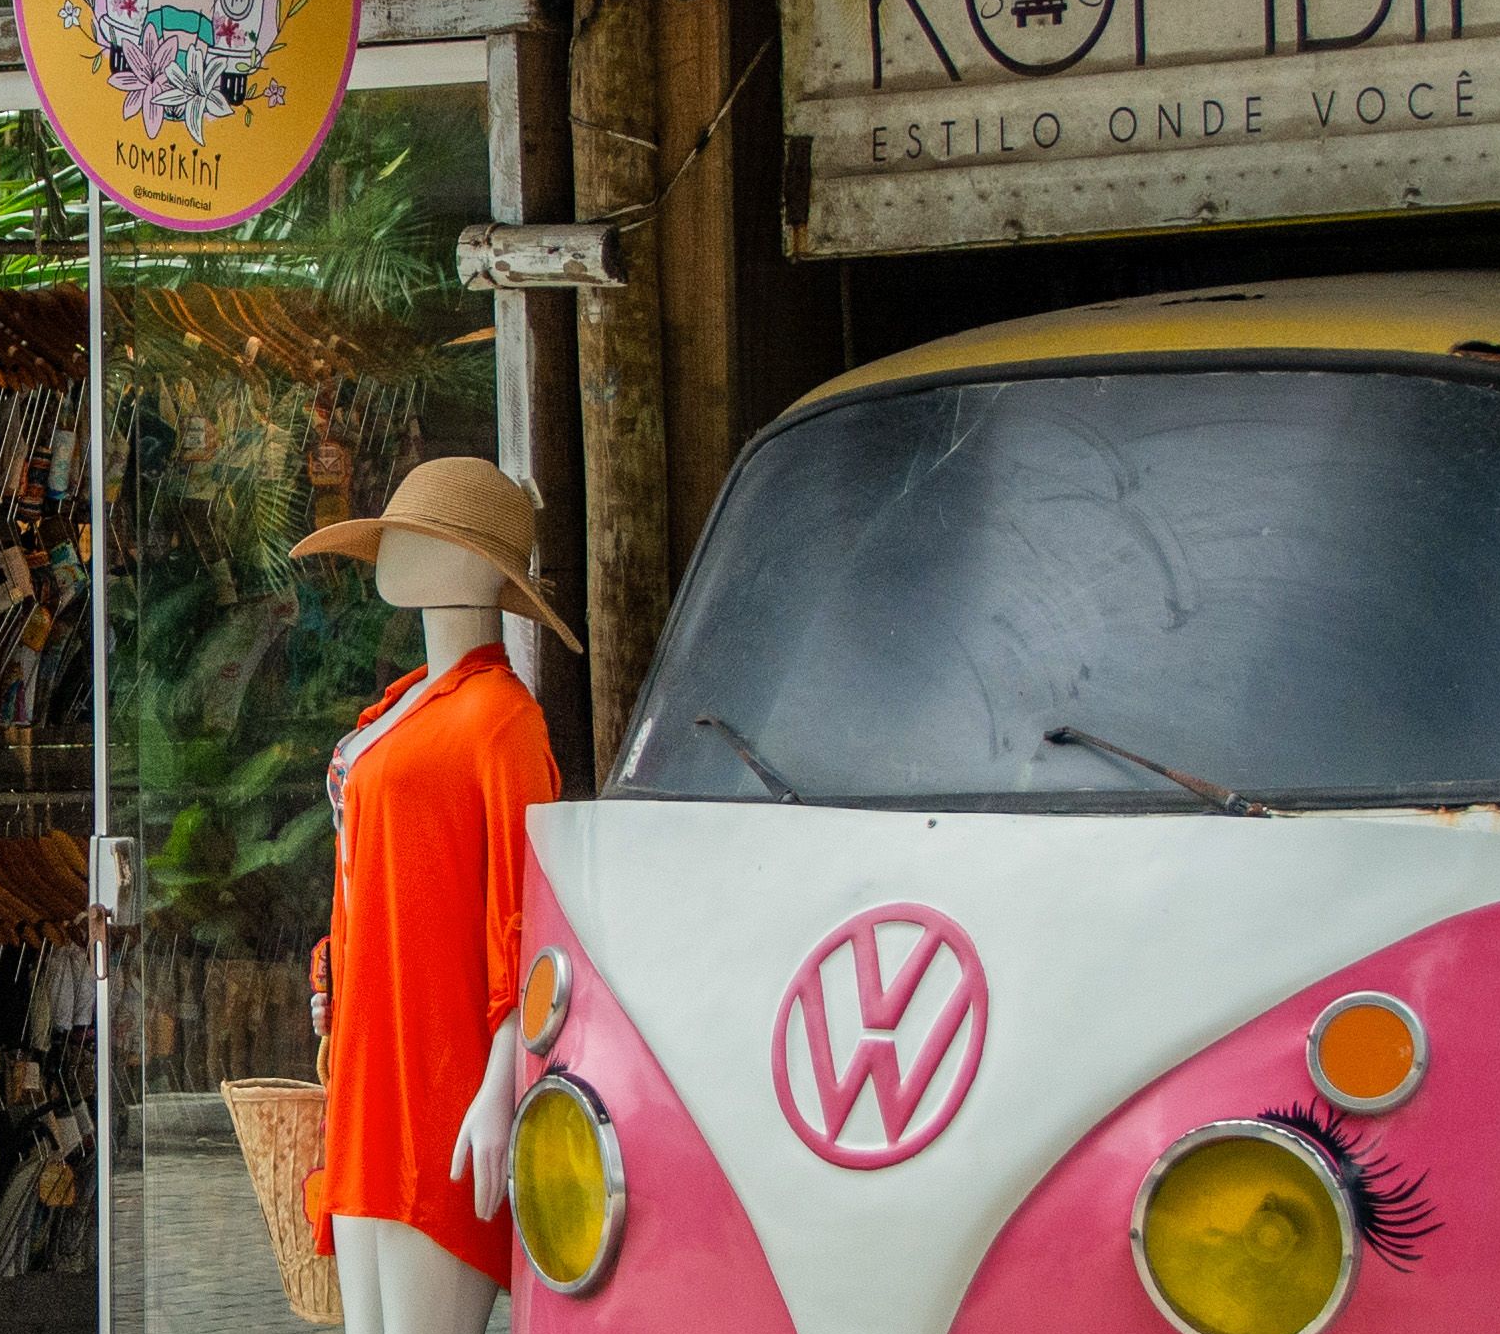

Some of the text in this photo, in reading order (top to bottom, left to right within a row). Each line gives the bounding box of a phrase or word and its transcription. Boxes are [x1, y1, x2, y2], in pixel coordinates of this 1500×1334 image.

[871, 111, 1063, 164] ESTILO
[1108, 94, 1264, 144] ONDE
[1310, 69, 1478, 129] VOCÊ
[133, 185, 212, 211] @kombikinioficial
